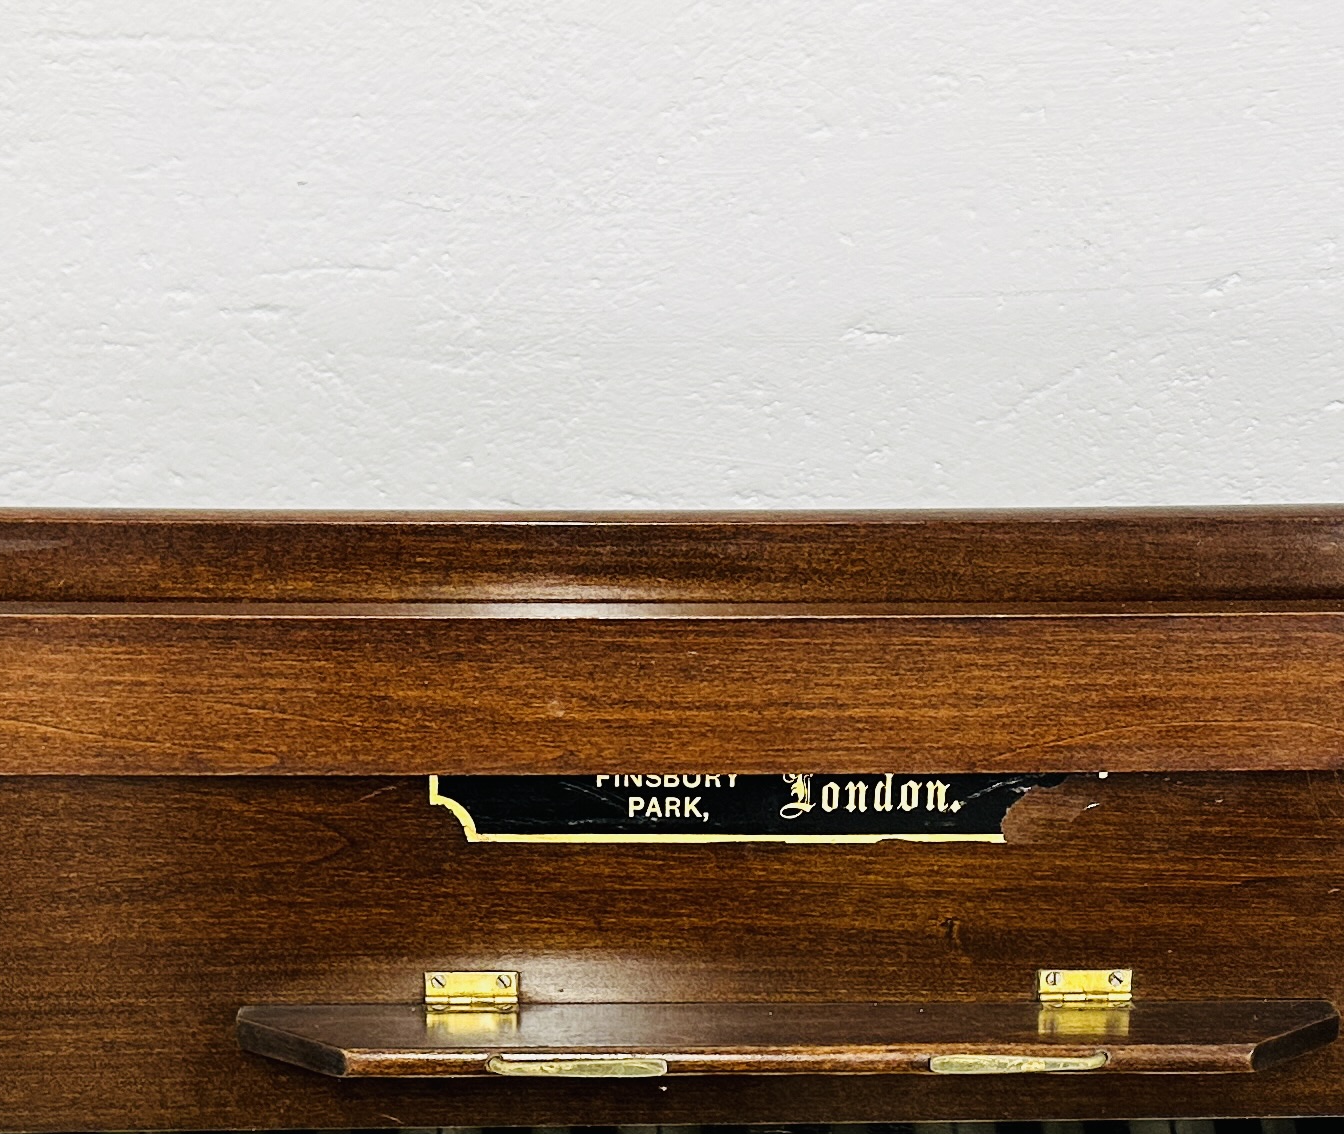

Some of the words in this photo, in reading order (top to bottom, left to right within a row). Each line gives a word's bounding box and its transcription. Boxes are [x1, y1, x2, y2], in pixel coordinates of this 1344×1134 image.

[596, 774, 737, 788] FINSBURY
[628, 796, 709, 822] PARK,
[780, 773, 961, 819] London.
